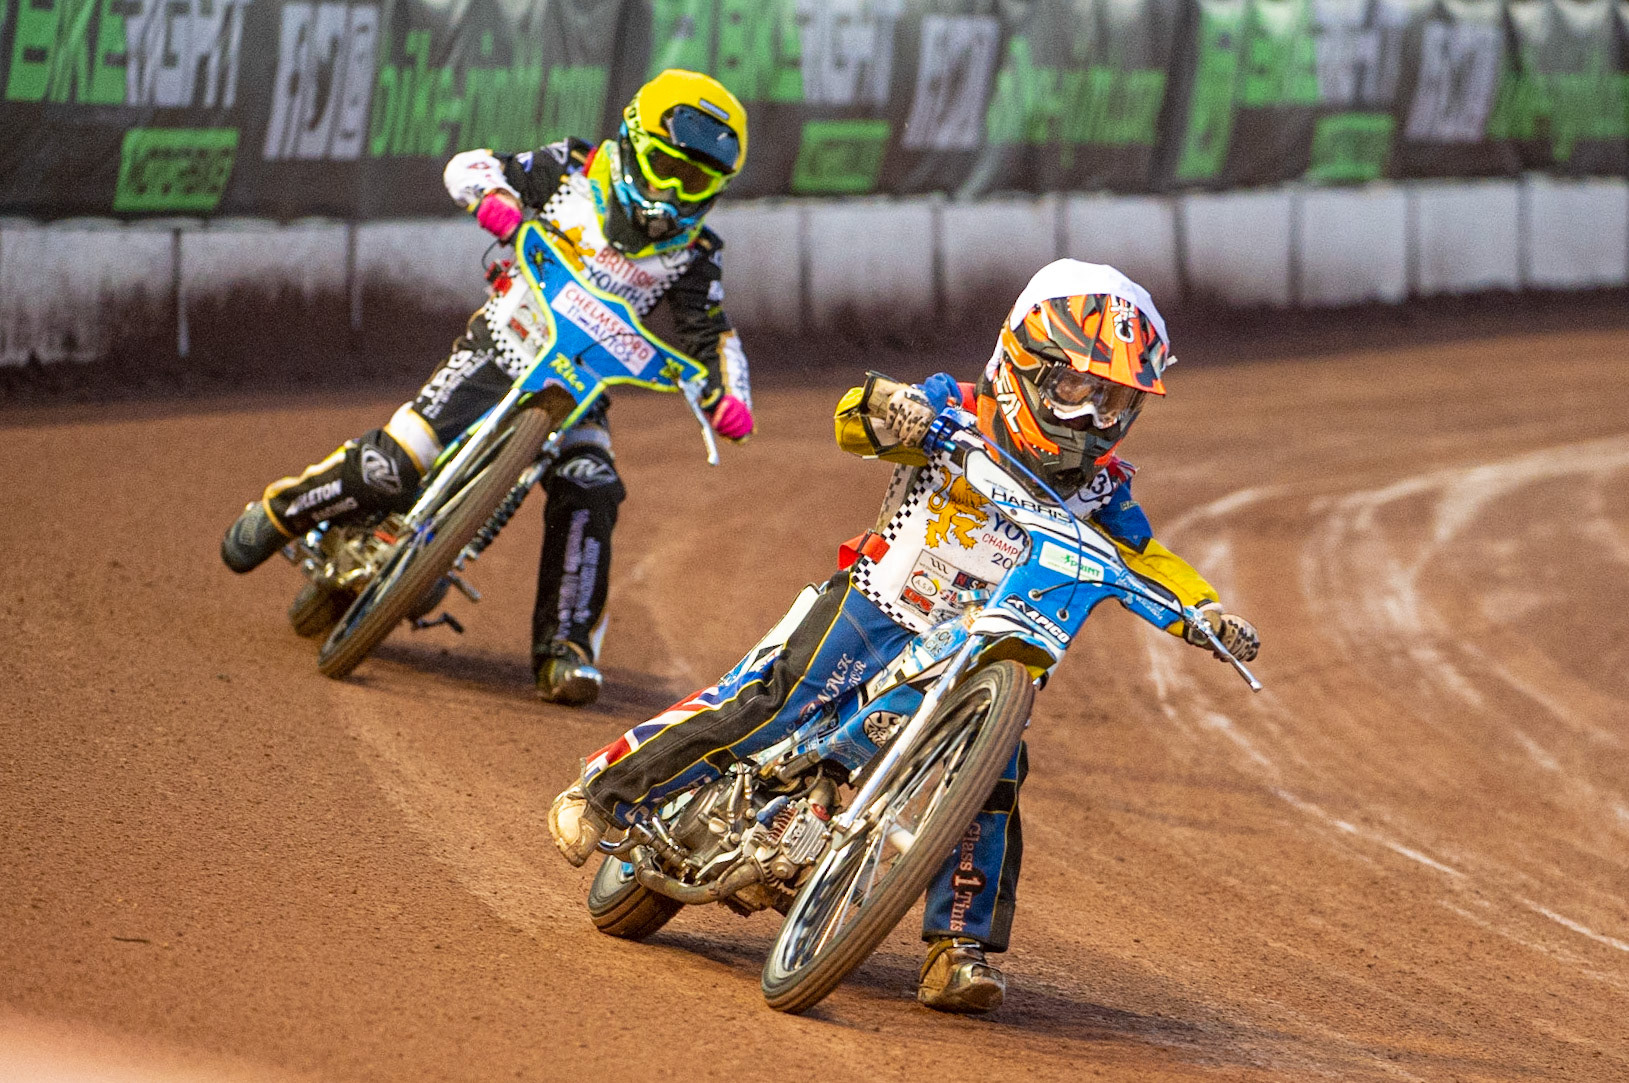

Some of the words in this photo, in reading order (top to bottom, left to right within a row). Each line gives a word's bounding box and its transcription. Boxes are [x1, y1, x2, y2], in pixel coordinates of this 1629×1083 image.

[991, 487, 1073, 524] HARRIS
[991, 552, 1014, 570] 20
[1025, 610, 1071, 644] APICO
[954, 874, 982, 888] 1
[949, 890, 973, 933] Tints
